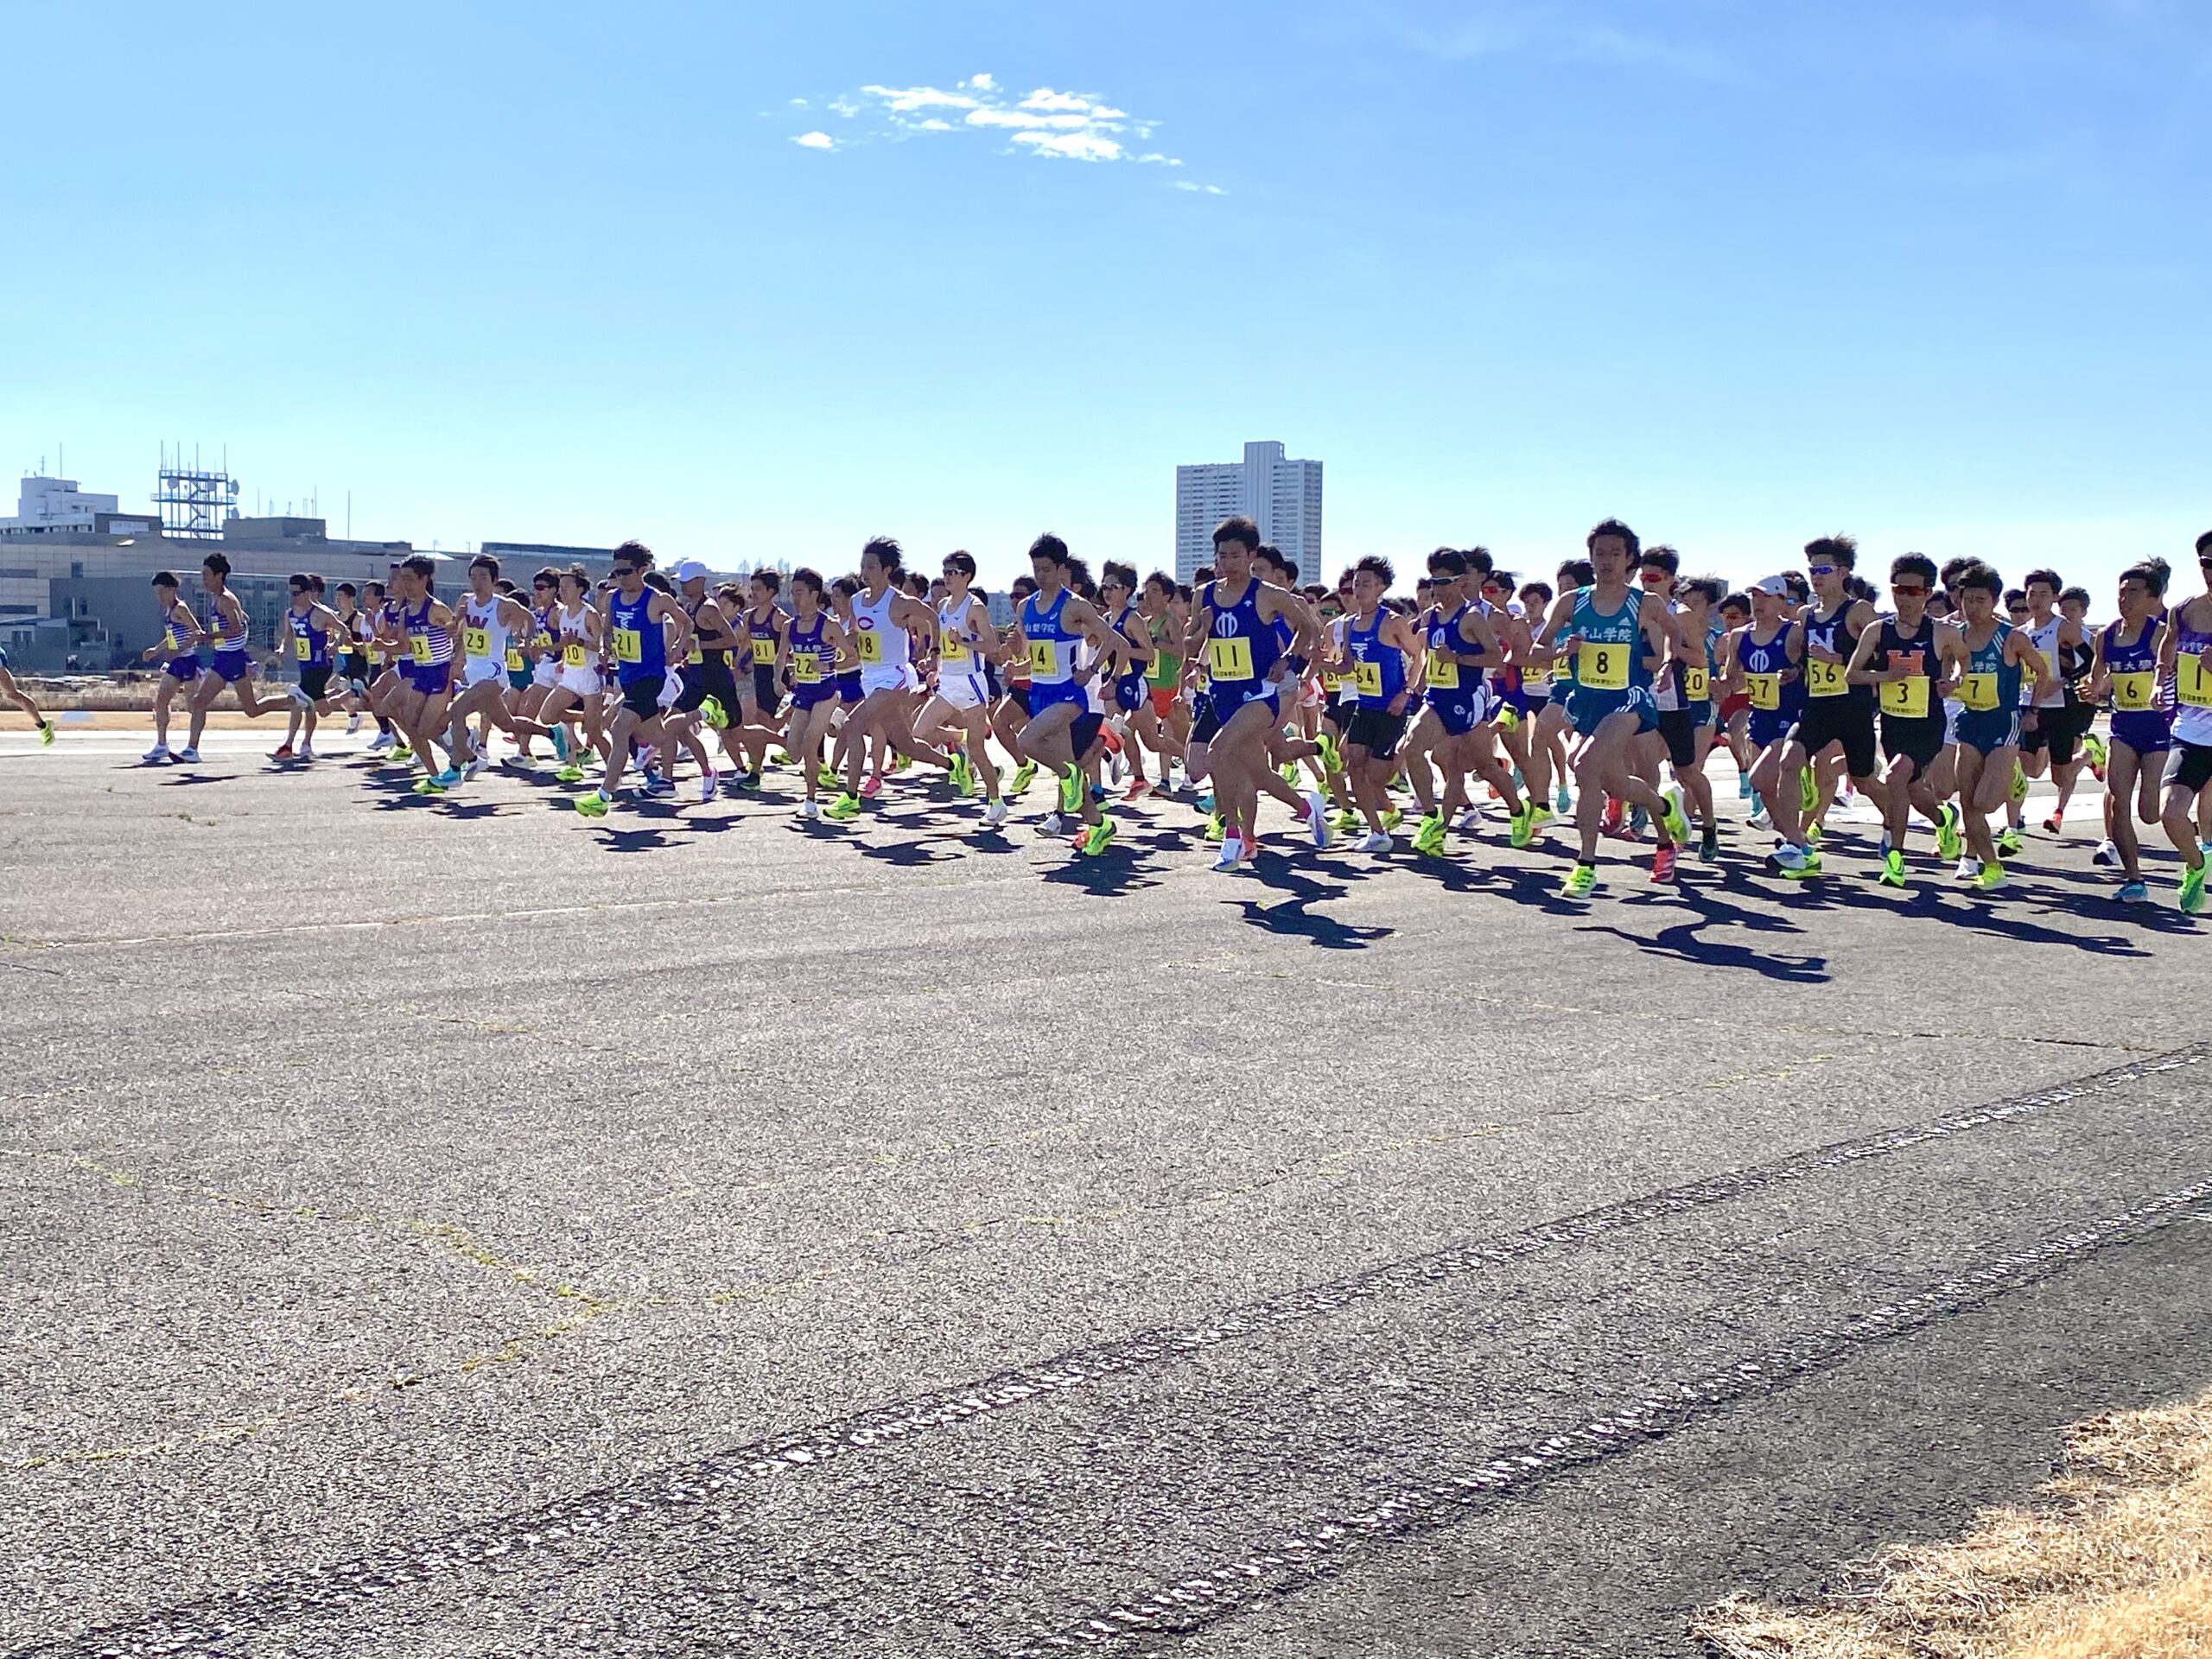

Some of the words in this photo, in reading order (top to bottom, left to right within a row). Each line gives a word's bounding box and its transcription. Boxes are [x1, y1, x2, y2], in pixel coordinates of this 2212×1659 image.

[466, 613, 488, 629] W
[857, 616, 874, 631] C
[467, 632, 485, 649] 29
[617, 633, 631, 653] 21
[754, 644, 768, 657] 81
[859, 635, 873, 654] 18
[1808, 627, 1837, 657] N
[1029, 645, 1046, 665] 14
[1216, 645, 1238, 668] 11
[1596, 651, 1609, 674] 8
[1887, 650, 1926, 676] H
[795, 658, 813, 674] 22
[1357, 667, 1375, 685] 64
[1811, 663, 1837, 684] 56
[1746, 677, 1769, 699] 57
[1897, 682, 1909, 704] 3
[1968, 679, 1979, 700] 7
[2126, 680, 2138, 699] 6
